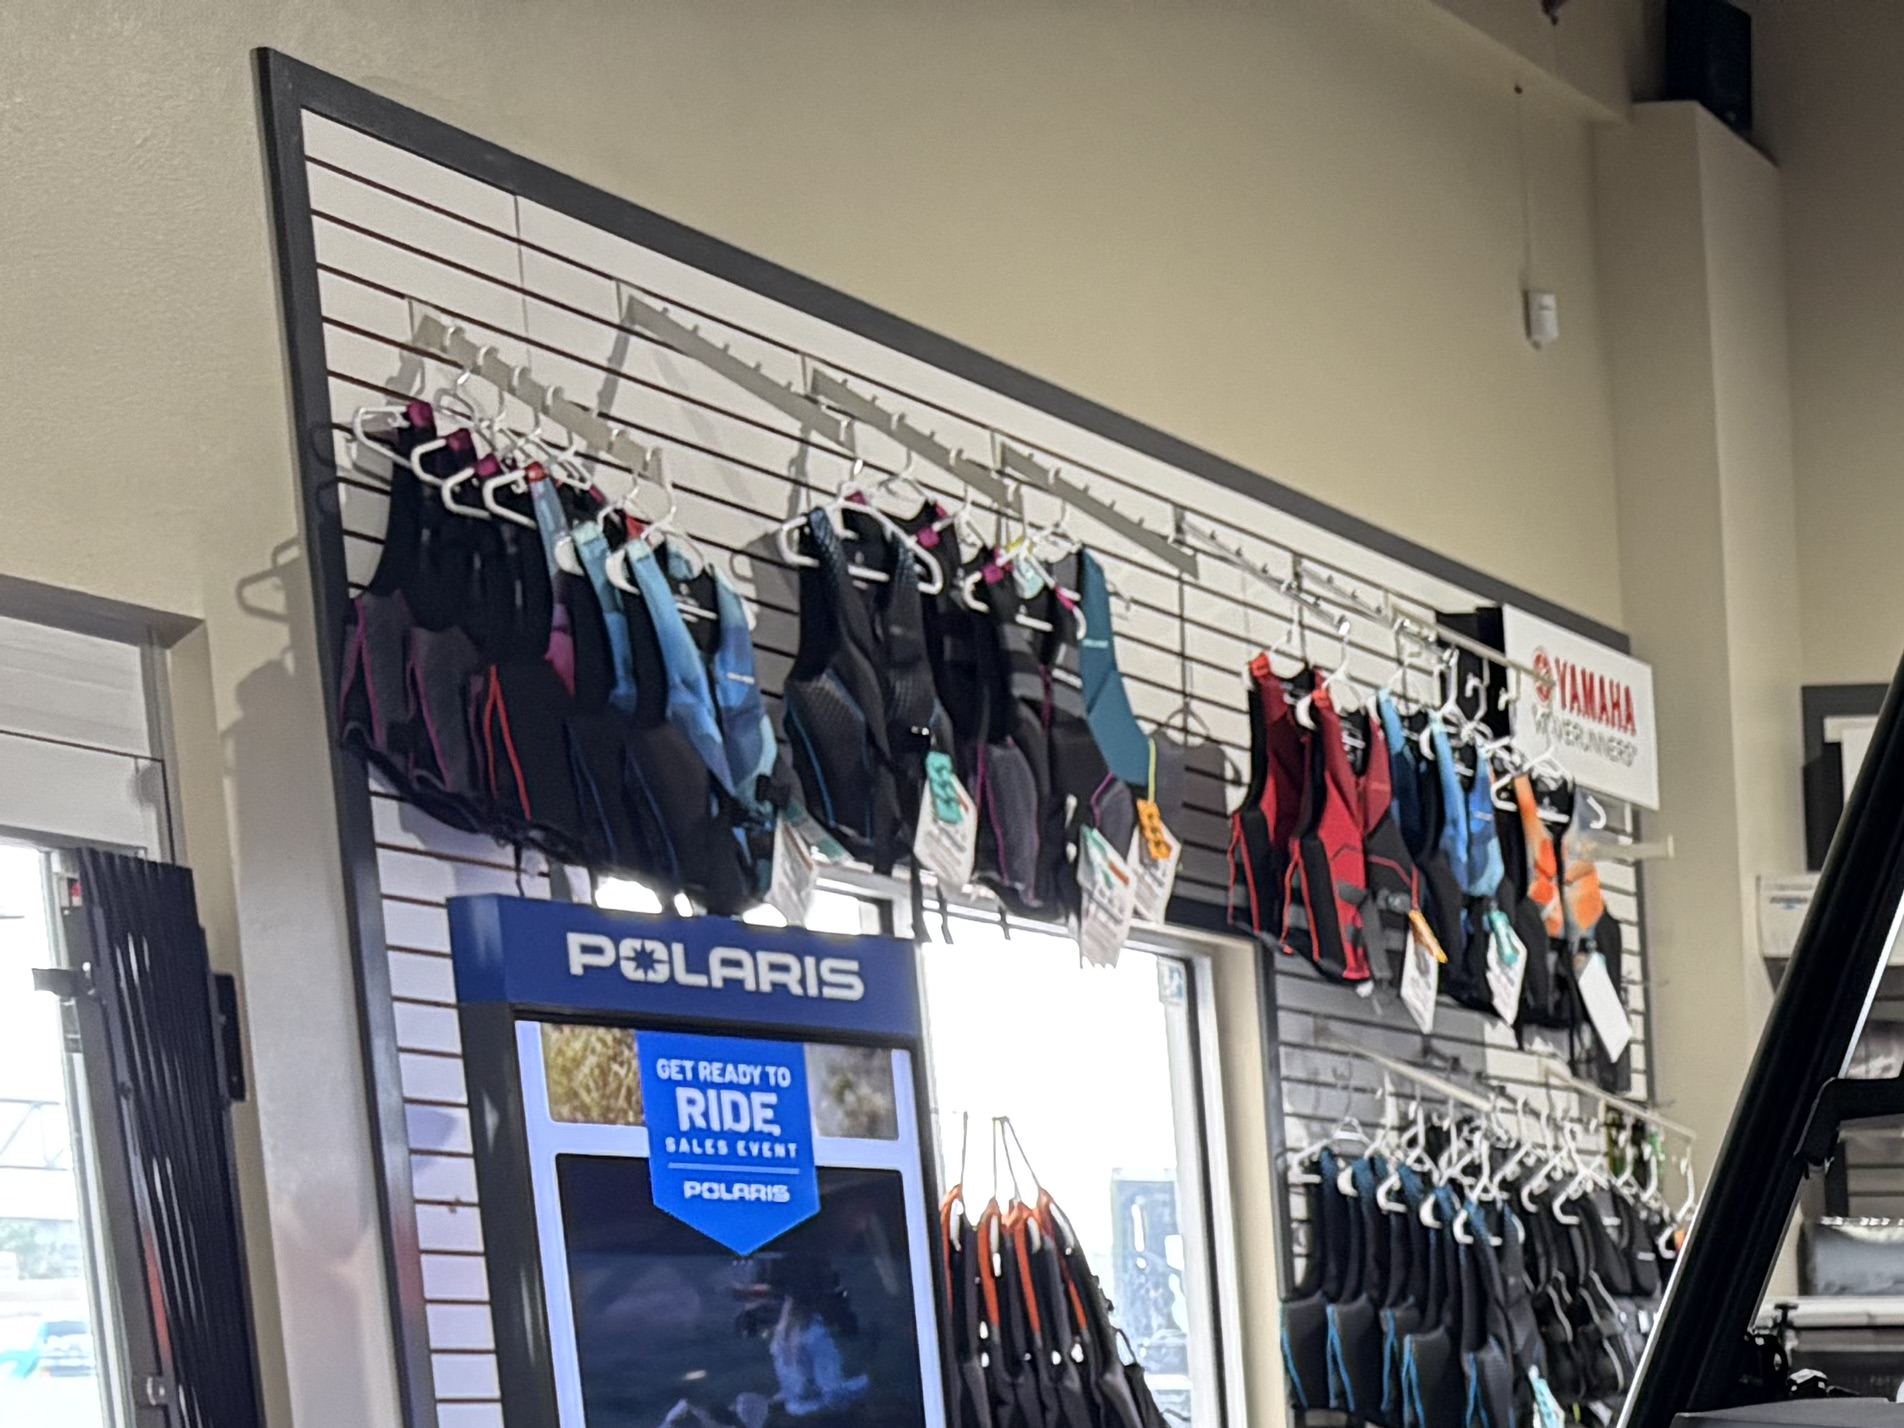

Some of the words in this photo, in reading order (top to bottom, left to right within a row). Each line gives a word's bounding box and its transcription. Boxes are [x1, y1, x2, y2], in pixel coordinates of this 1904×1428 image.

[1554, 656, 1637, 736] YAMAHA
[566, 931, 865, 1001] POLARIS
[656, 1058, 694, 1082] GET
[697, 1060, 763, 1087] READY
[765, 1065, 791, 1088] TO
[676, 1086, 782, 1137] RIDE
[664, 1136, 728, 1156] SALES
[736, 1140, 798, 1160] EVENT
[682, 1179, 791, 1203] POLARIS
